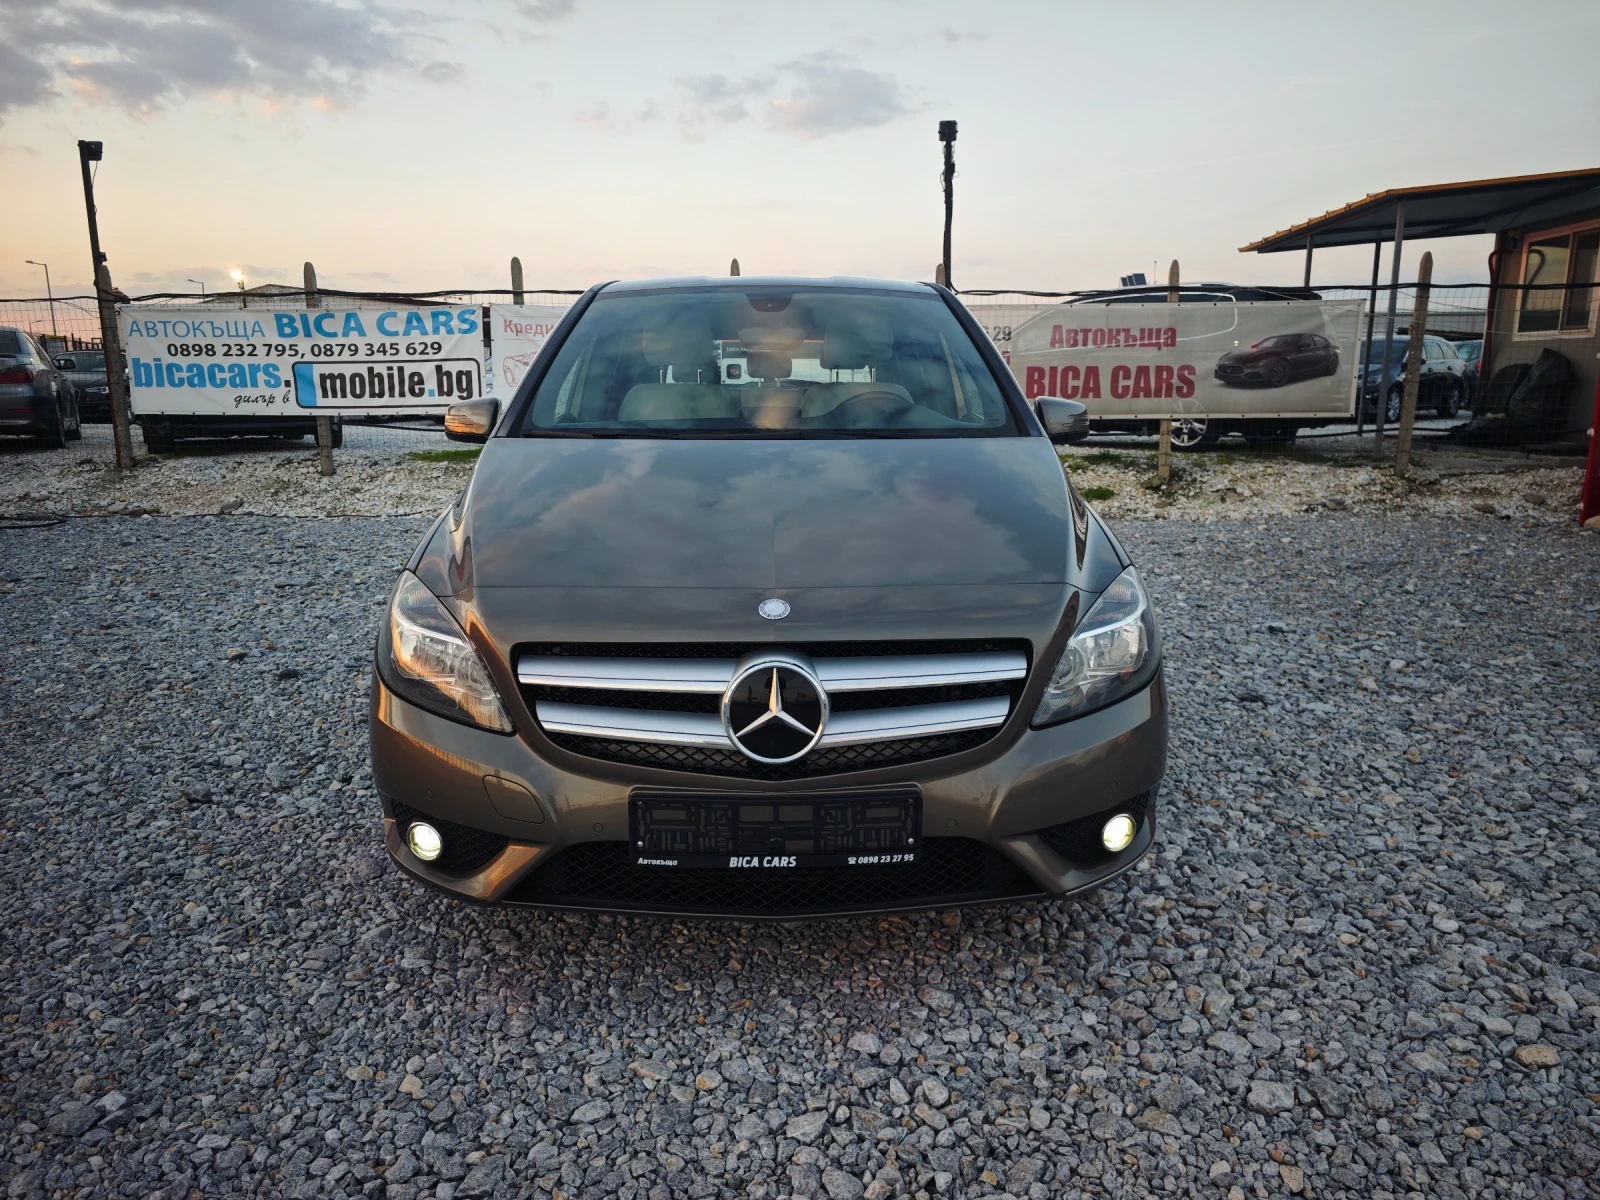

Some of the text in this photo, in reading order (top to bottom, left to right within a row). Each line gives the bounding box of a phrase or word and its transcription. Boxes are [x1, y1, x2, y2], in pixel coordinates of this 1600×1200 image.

[128, 309, 479, 341] АВТОКЪЩА BICA CARS
[1050, 324, 1178, 351] Автокъща
[167, 341, 443, 359] 0898 232 795, 0879 345 629
[319, 364, 474, 401] mobile.bg
[1025, 365, 1197, 399] BICA CARS
[637, 857, 678, 866] Автокъща
[729, 855, 797, 868] BICA CARS
[857, 853, 915, 865] 0898 23 27 95
